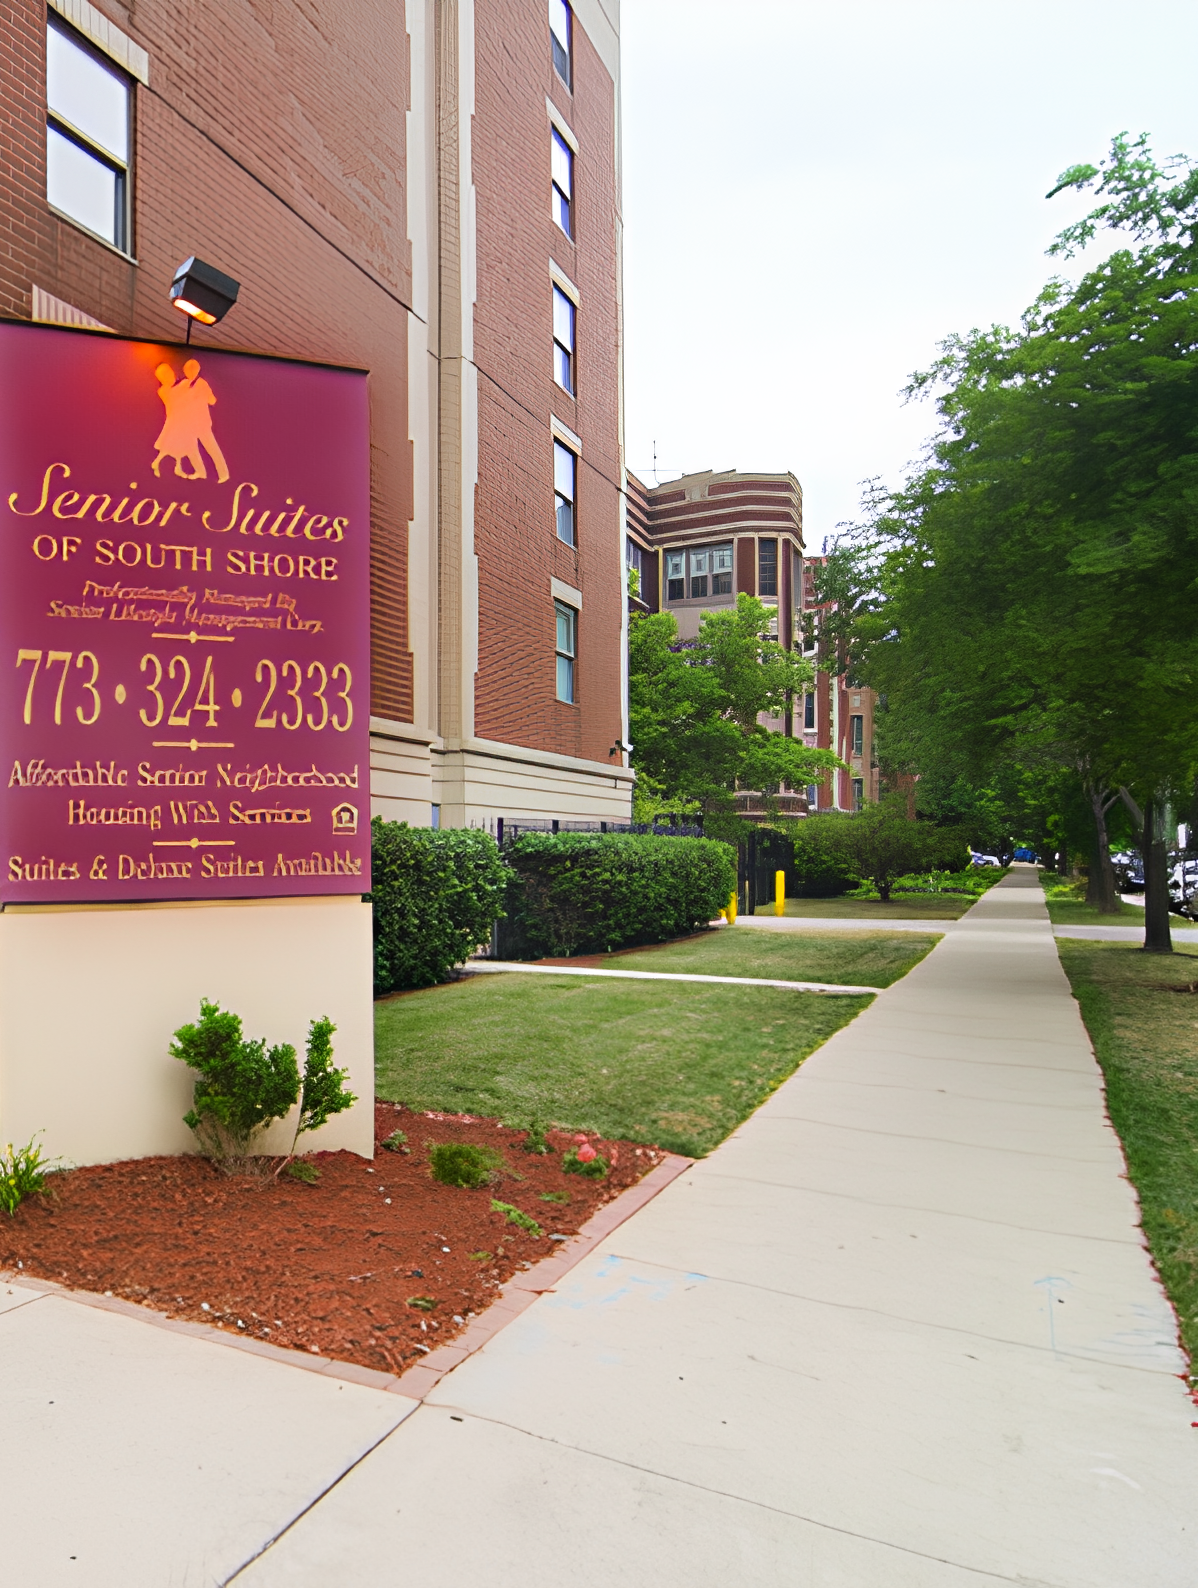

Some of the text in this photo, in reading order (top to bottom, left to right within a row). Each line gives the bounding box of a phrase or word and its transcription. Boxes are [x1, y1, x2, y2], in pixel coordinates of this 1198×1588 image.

[8, 461, 349, 543] Senior Suites
[32, 534, 339, 581] OF SOUTH SHORE
[15, 649, 354, 732] 773 324 2333
[7, 855, 81, 882] Suites
[89, 854, 108, 880] &
